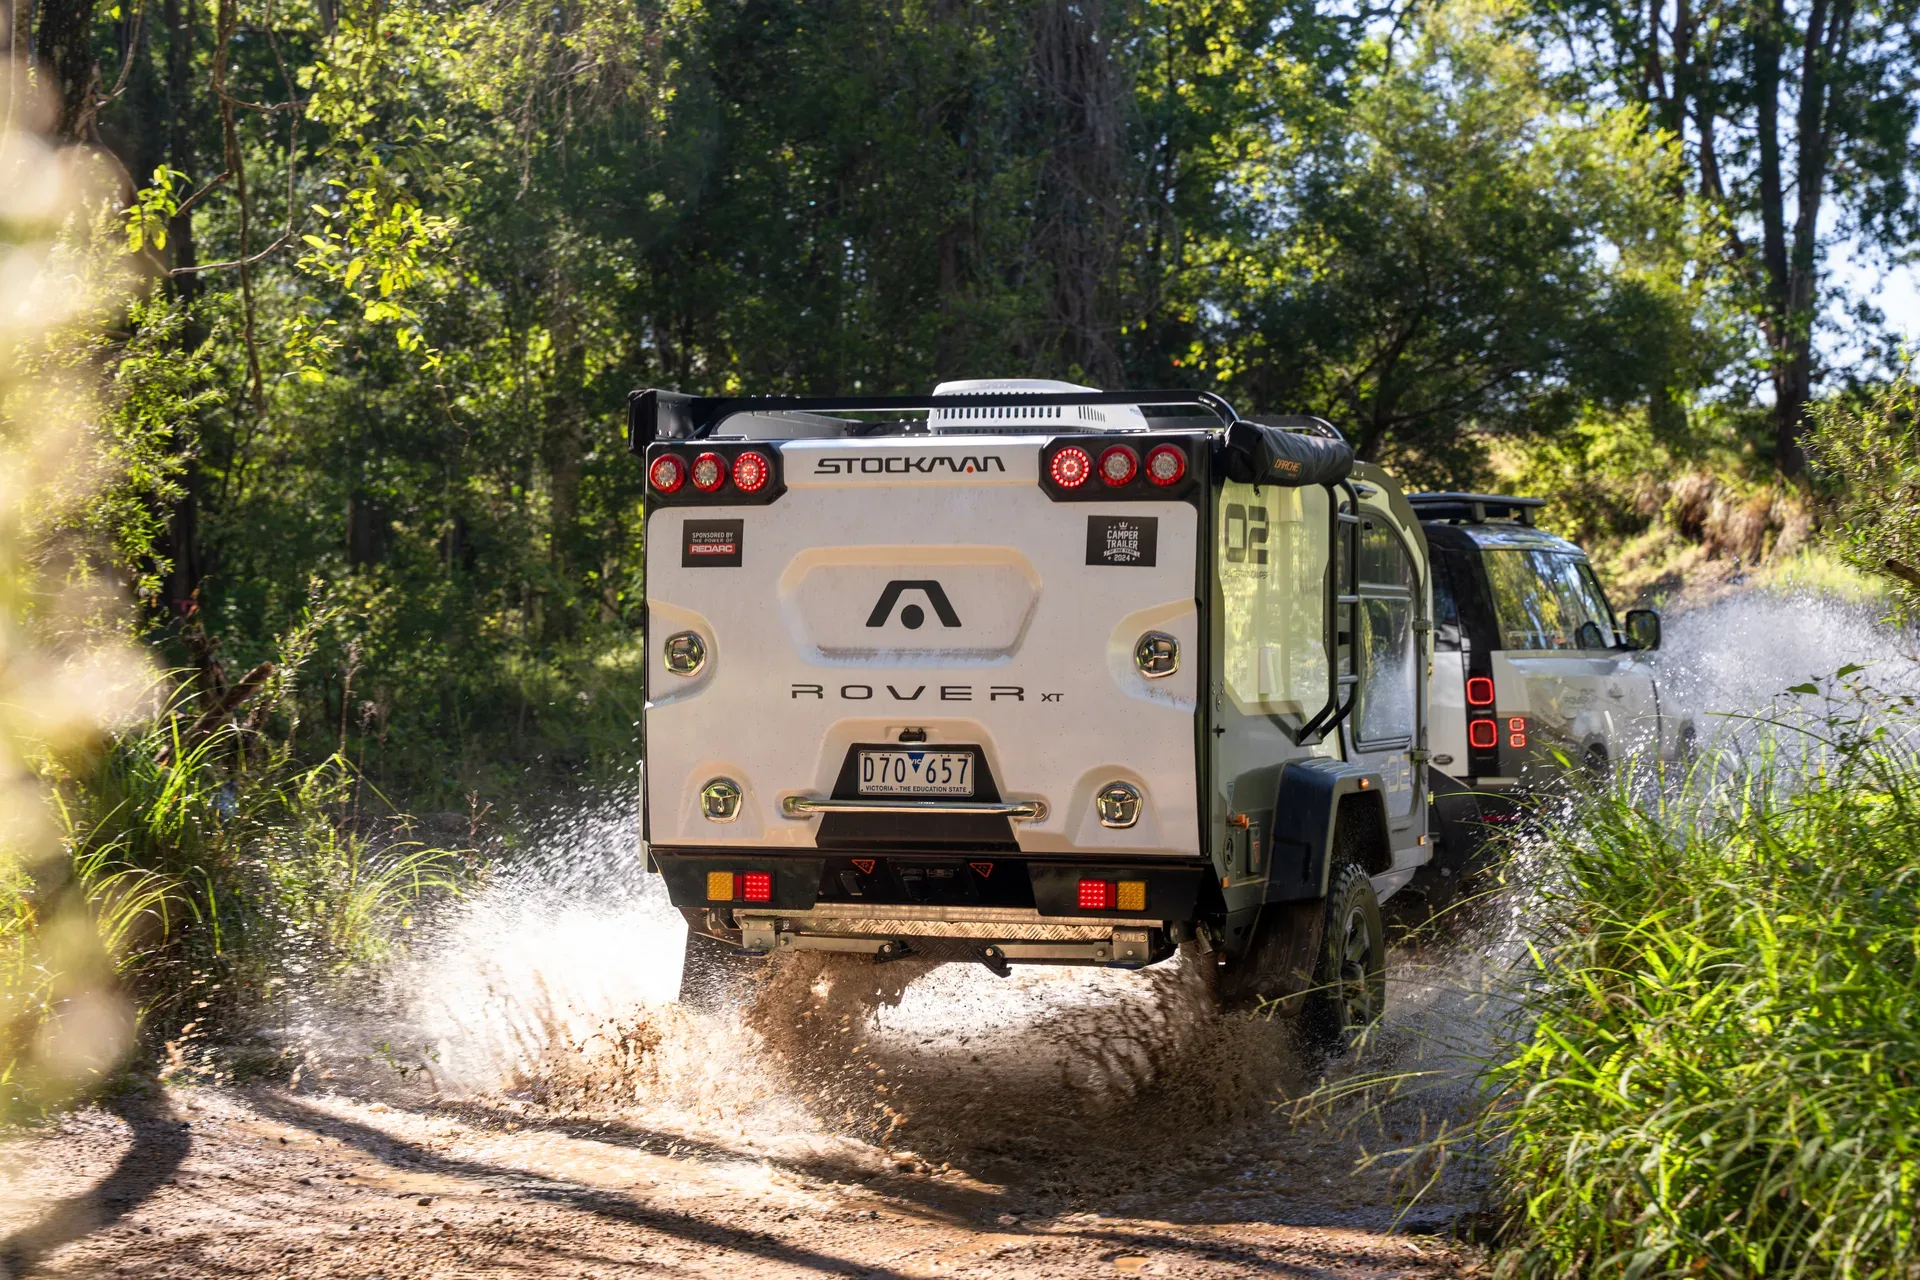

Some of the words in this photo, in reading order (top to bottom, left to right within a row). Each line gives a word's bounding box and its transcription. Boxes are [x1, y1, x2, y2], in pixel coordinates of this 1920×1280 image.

[814, 456, 1005, 474] STOCKMAN
[1273, 458, 1302, 472] DARCHE
[1107, 530, 1139, 540] CAMPER
[1225, 503, 1269, 564] 02
[691, 545, 733, 553] REDARC
[1106, 540, 1138, 550] TRAILER
[1113, 554, 1131, 562] 2024
[791, 684, 1025, 702] ROVER
[1041, 692, 1065, 703] XT
[863, 757, 906, 783] D70
[925, 758, 969, 784] 657
